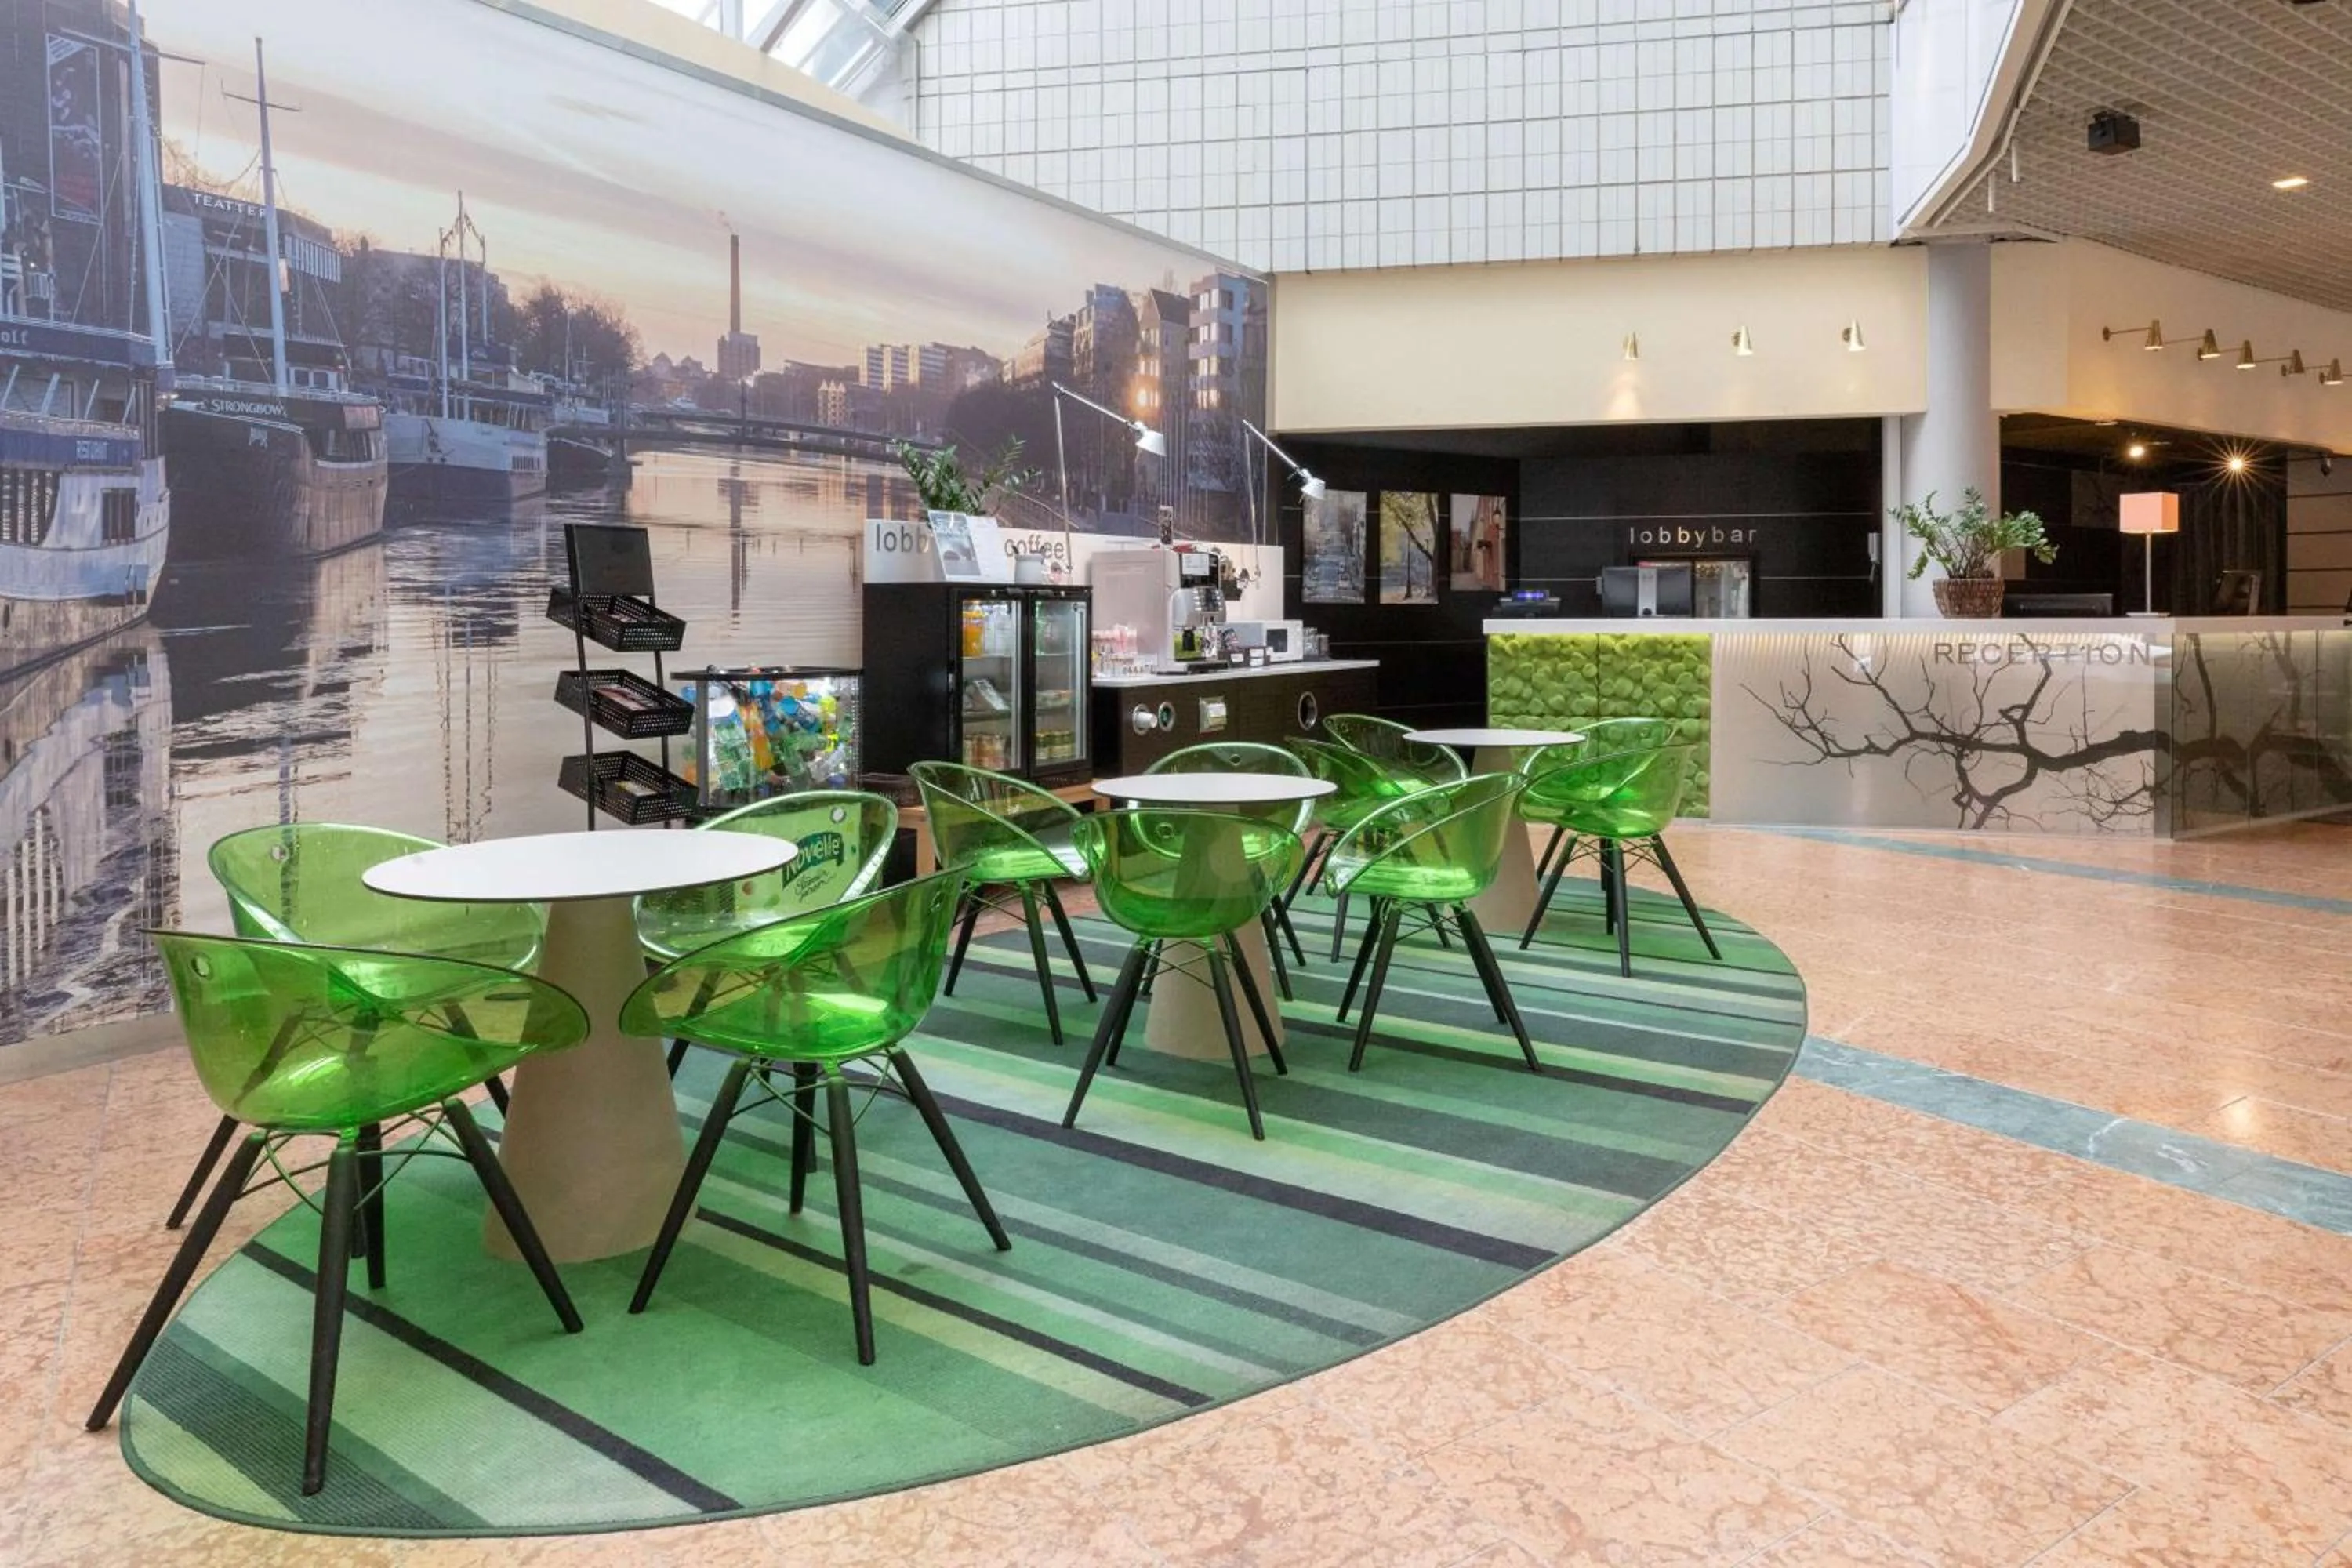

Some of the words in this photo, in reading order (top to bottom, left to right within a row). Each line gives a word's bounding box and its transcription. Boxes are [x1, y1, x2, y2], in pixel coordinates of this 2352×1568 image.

[211, 398, 286, 416] STRONGBOW
[876, 524, 930, 553] lobb
[1004, 534, 1065, 559] coffee
[1630, 526, 1757, 548] lobbybar
[1934, 642, 2151, 665] RECEPTION
